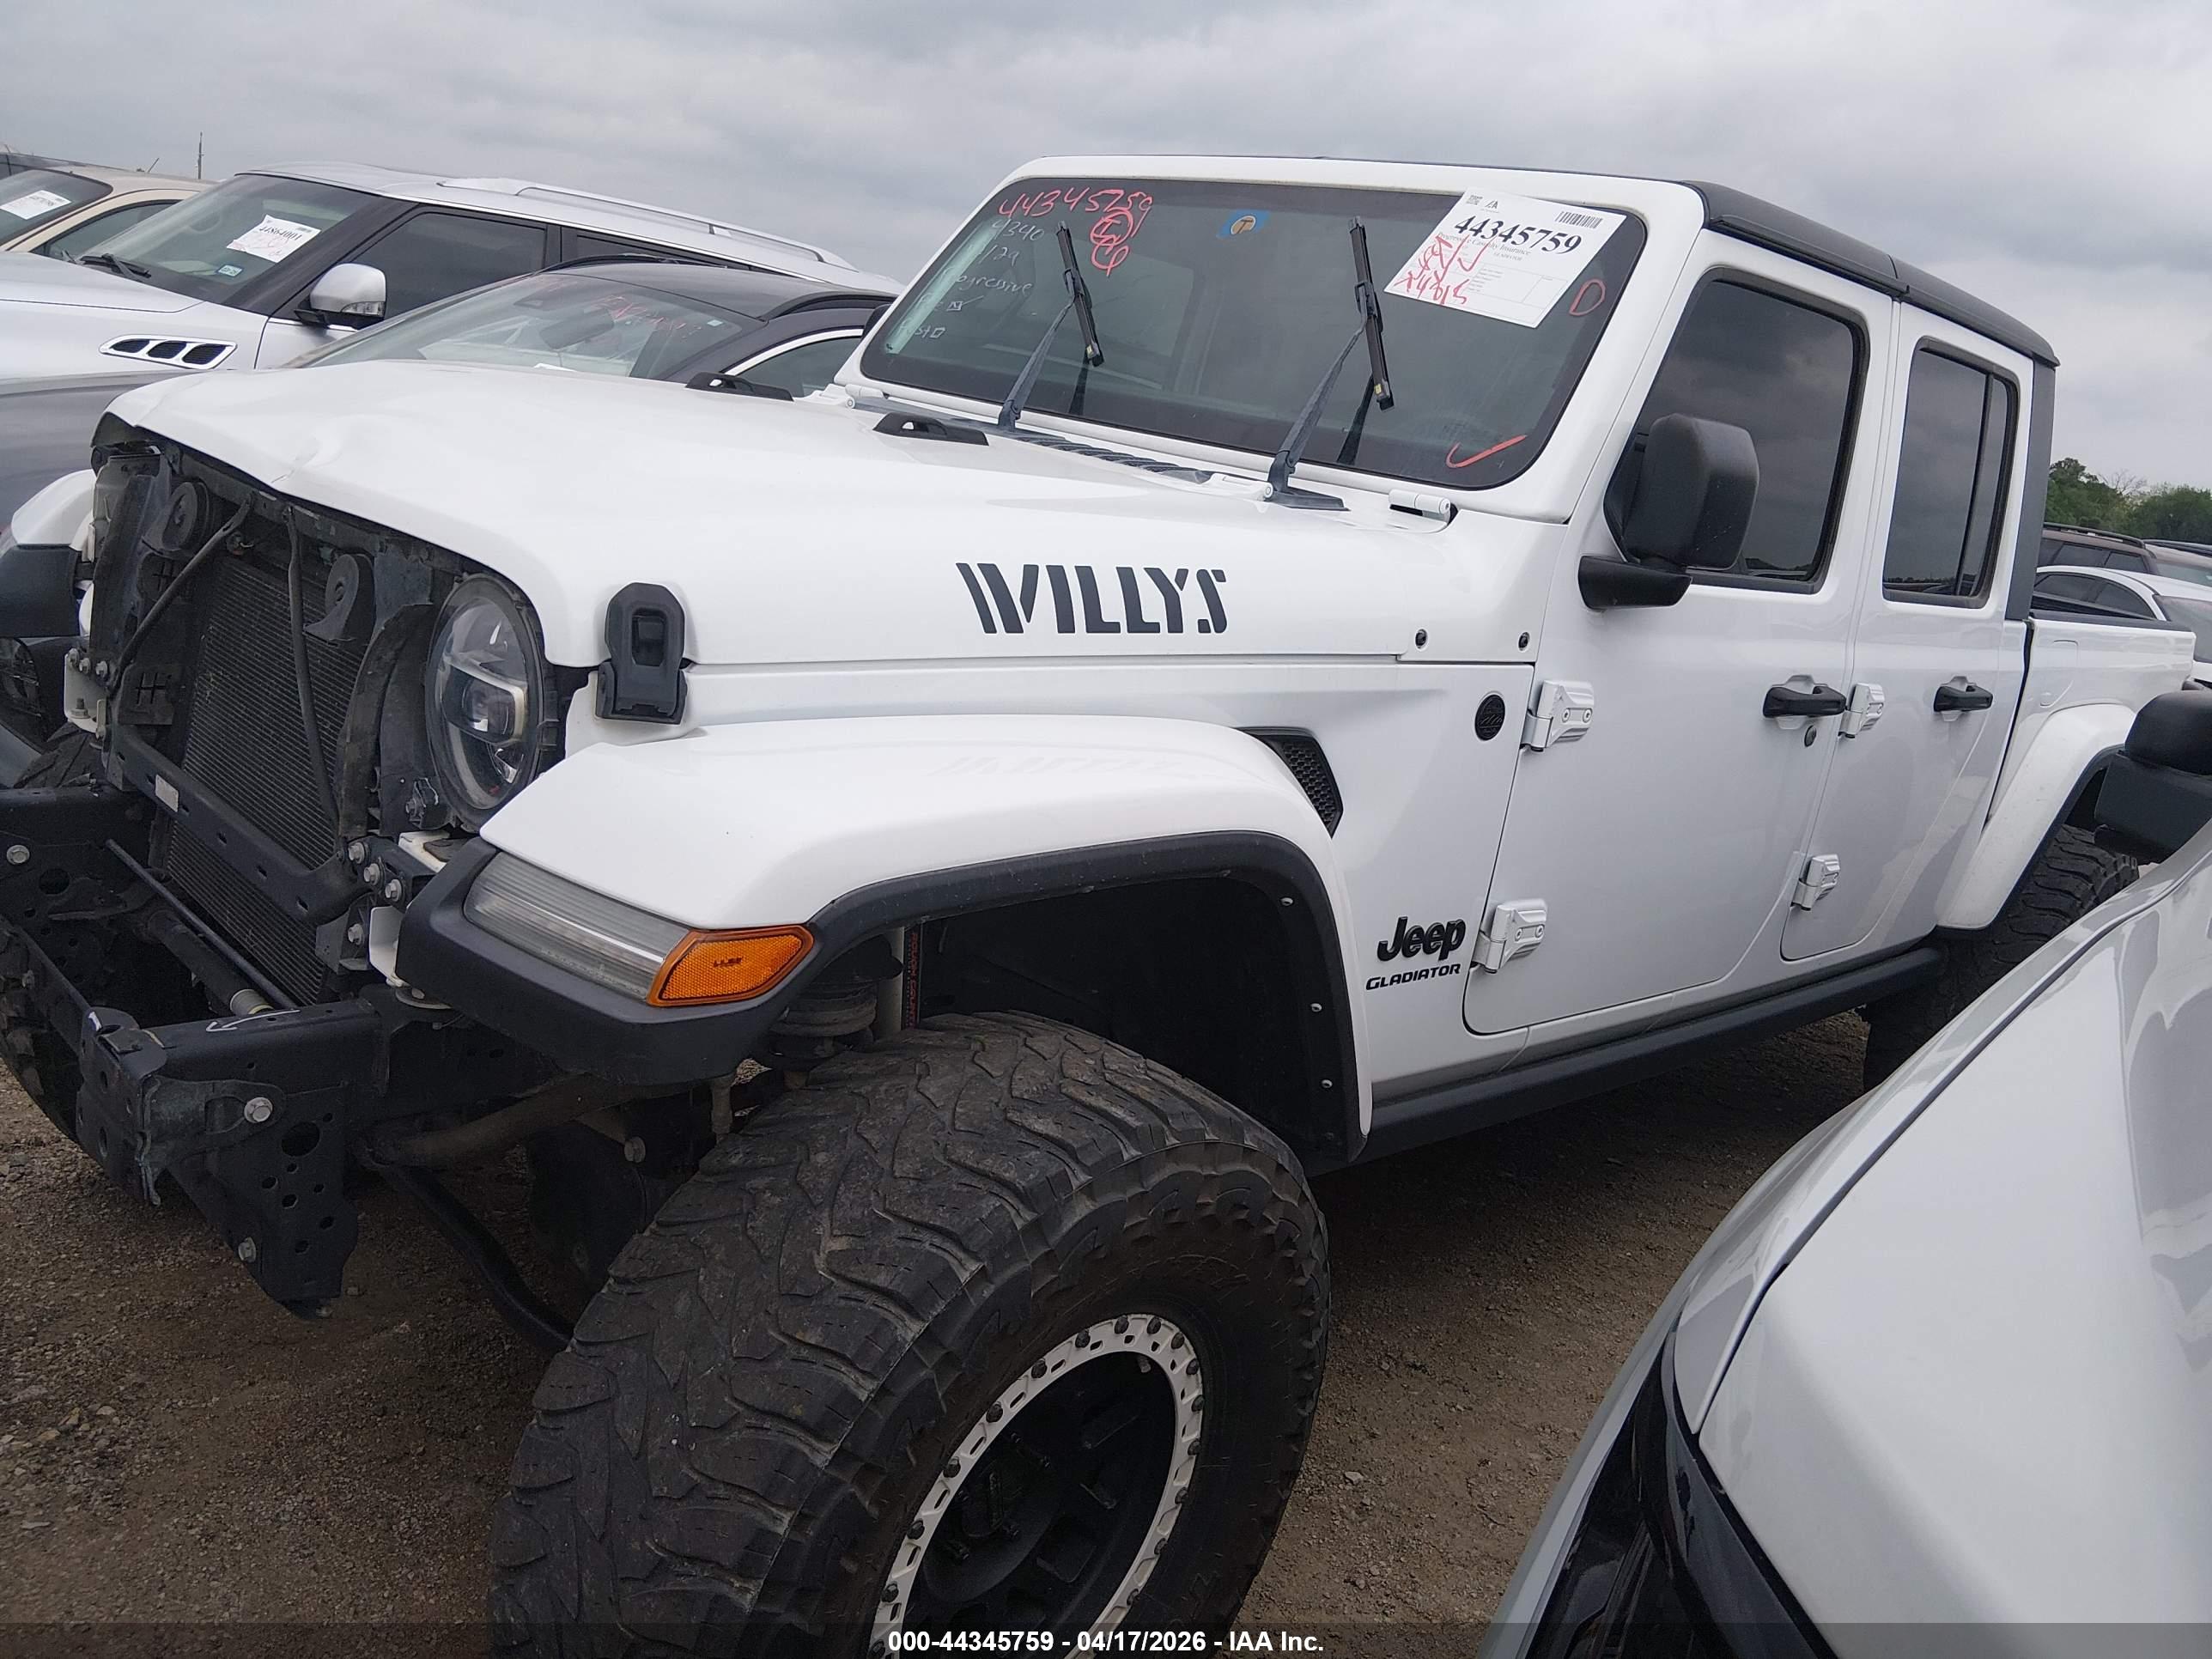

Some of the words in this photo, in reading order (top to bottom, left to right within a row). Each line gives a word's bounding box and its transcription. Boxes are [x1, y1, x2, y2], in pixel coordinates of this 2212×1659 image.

[1437, 232, 1472, 244] Progresse
[1472, 239, 1498, 251] Caslty
[1455, 216, 1583, 255] 44345759
[956, 562, 1228, 634] WILLYS
[1377, 916, 1466, 961] Jeep
[1365, 963, 1461, 991] GLADIATOR
